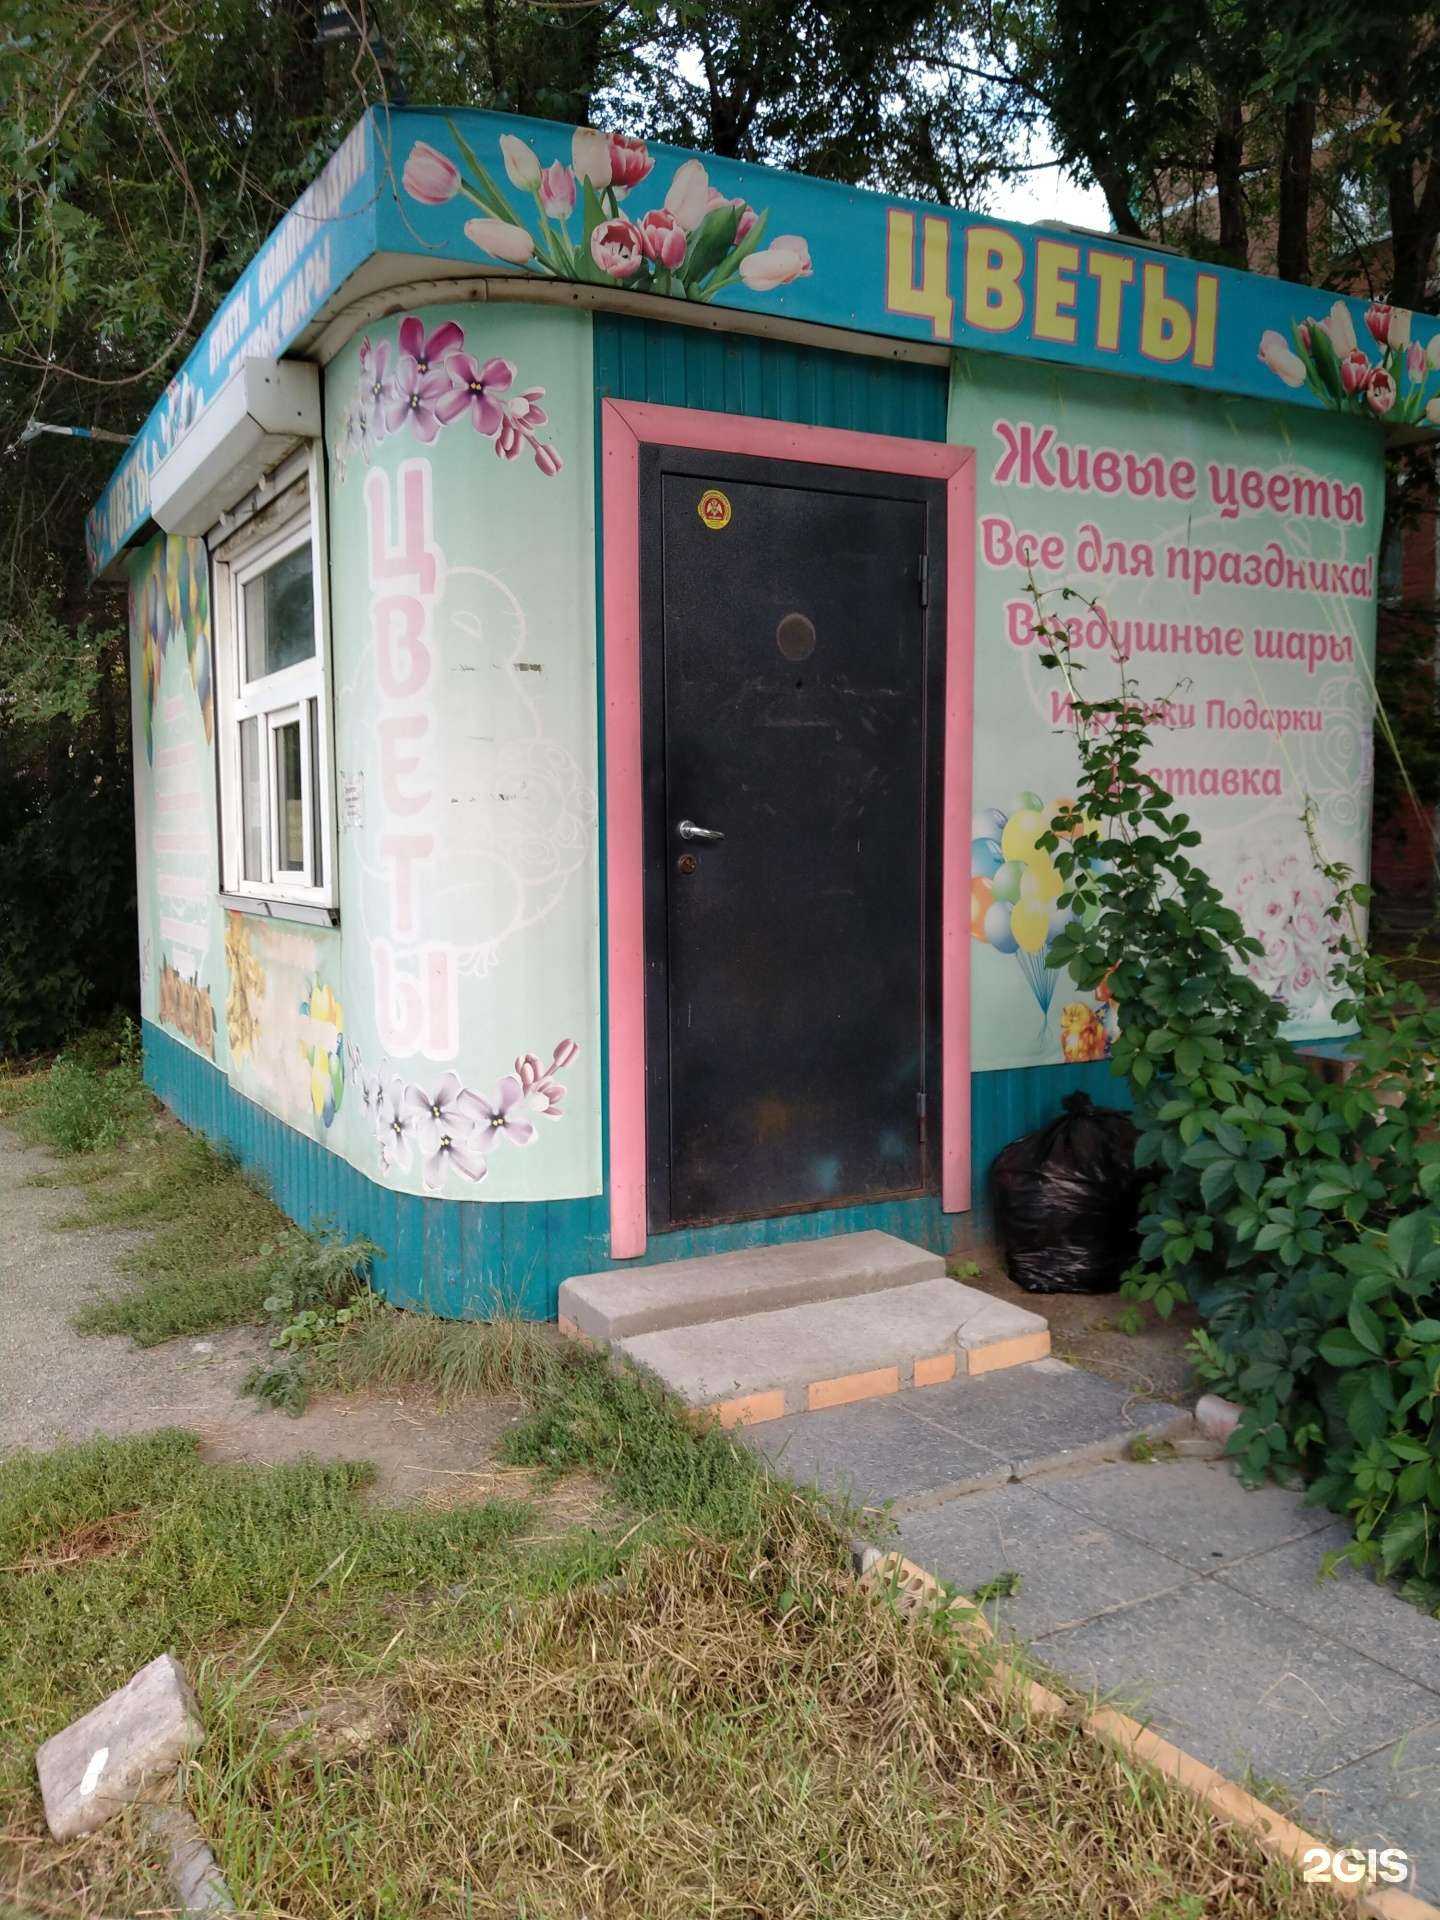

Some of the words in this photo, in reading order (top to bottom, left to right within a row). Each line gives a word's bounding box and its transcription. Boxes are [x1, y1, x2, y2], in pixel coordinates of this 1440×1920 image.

[884, 209, 1219, 370] ЦВЕТЫ
[993, 420, 1198, 500] Живые
[1208, 464, 1364, 524] цветы
[980, 518, 1065, 571] Все
[1076, 523, 1154, 579] для
[1166, 543, 1373, 598] праздника!
[1254, 629, 1354, 673] шары
[1206, 698, 1322, 734] Подарки
